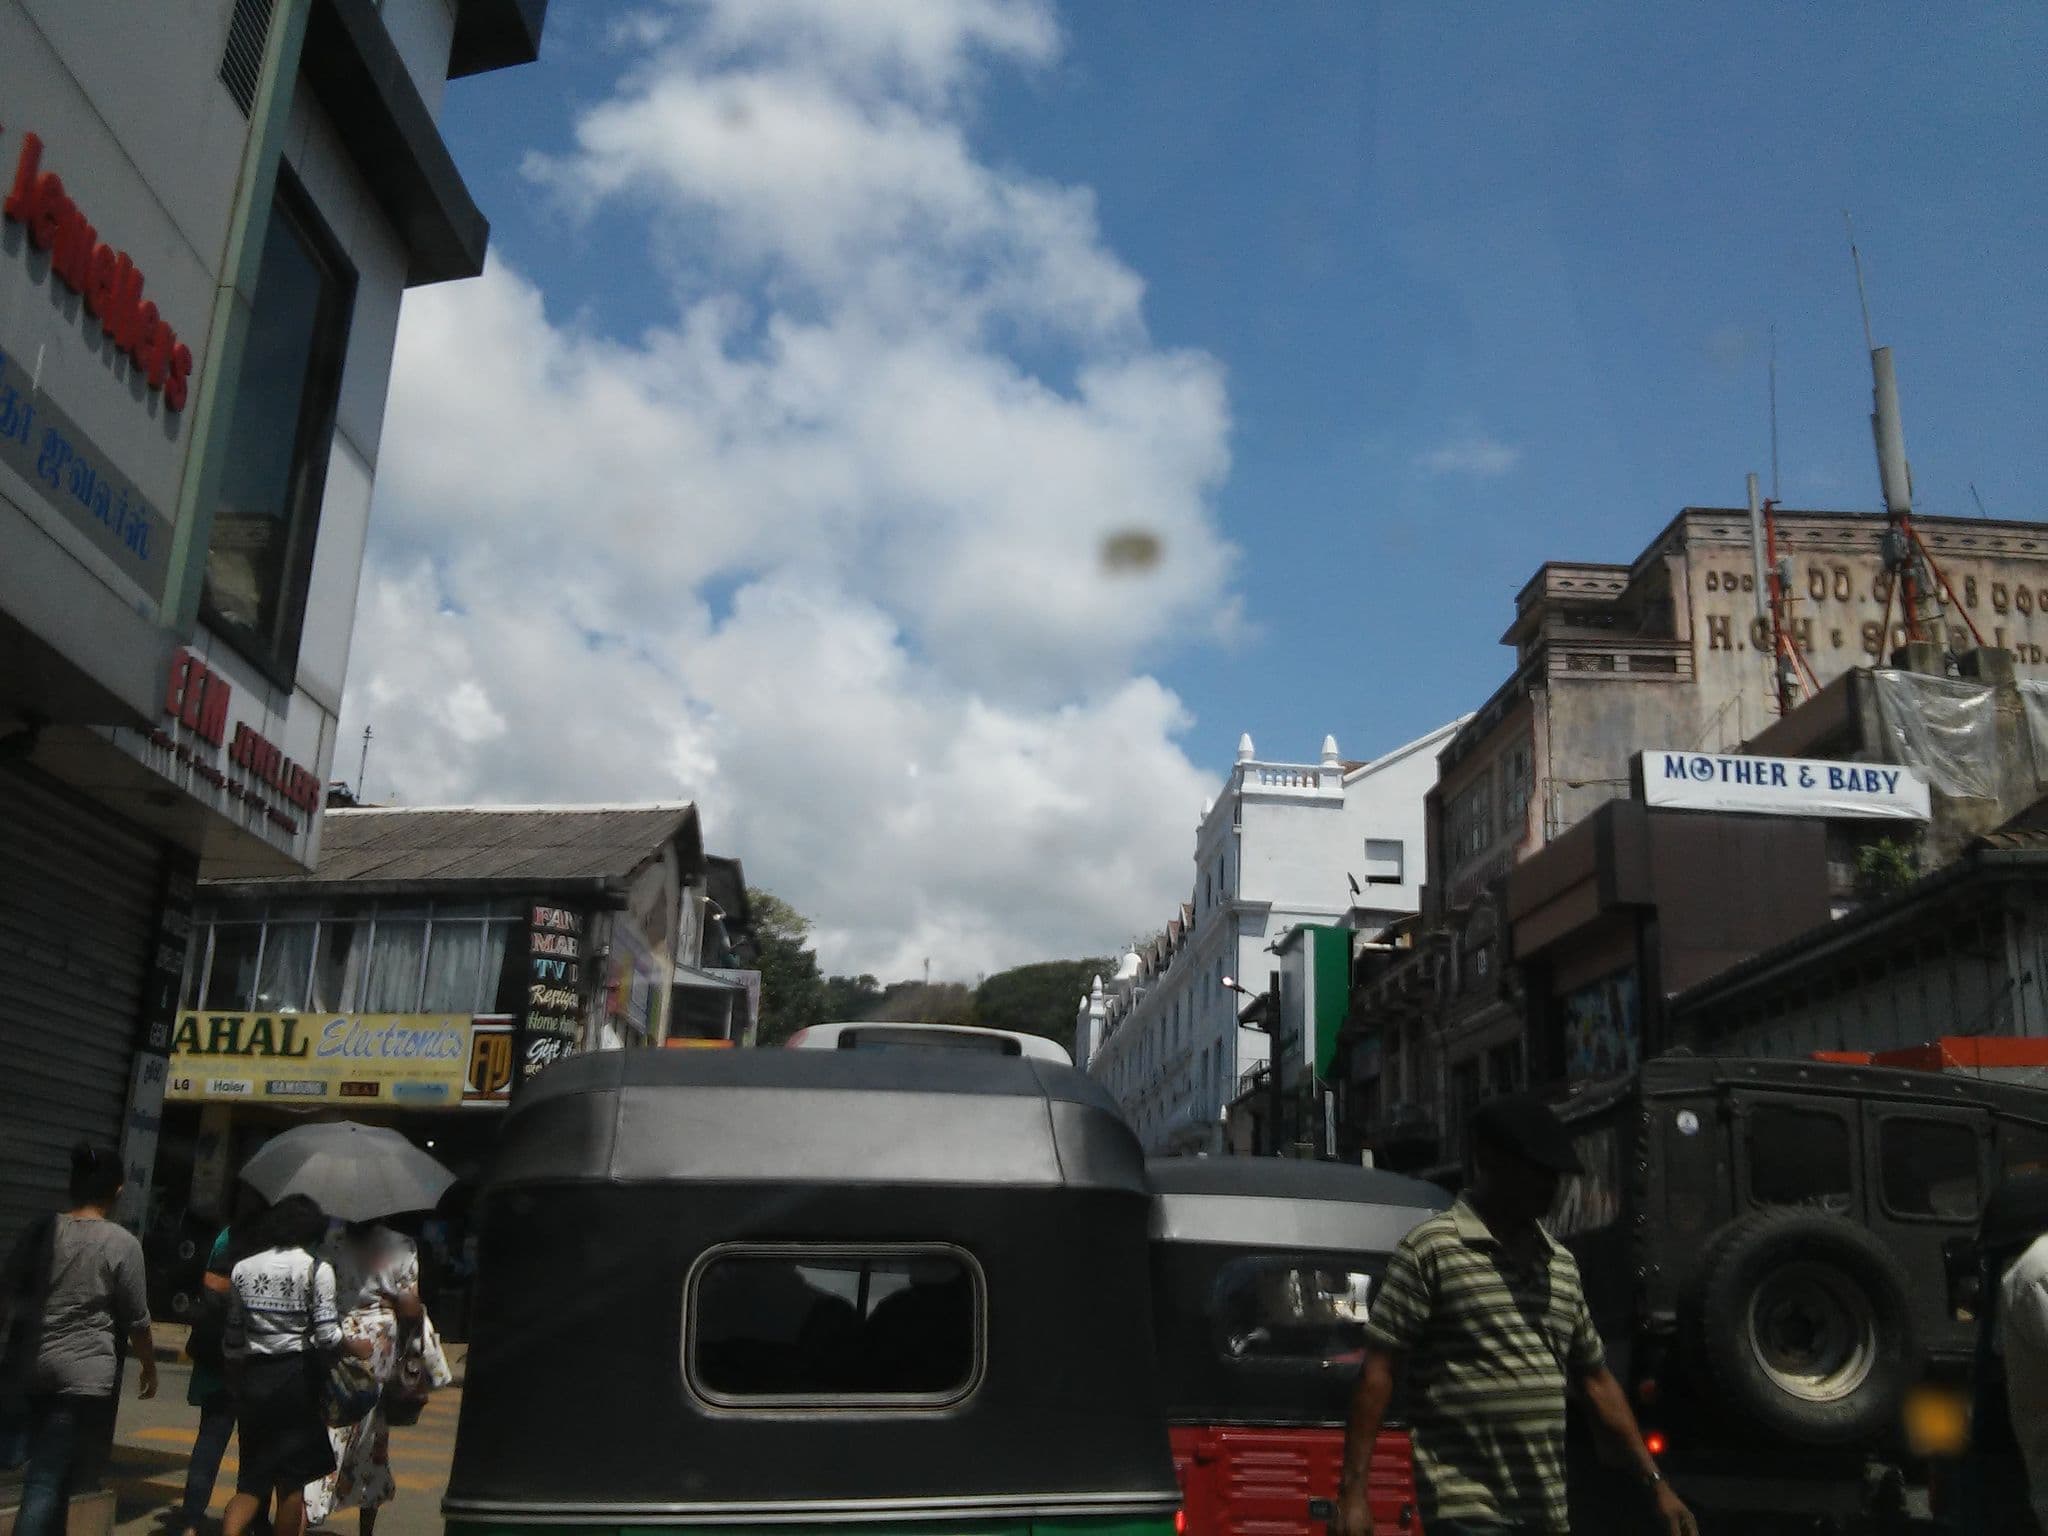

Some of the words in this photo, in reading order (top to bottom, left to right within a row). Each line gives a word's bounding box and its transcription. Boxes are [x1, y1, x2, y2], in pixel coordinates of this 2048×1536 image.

[1664, 755, 1788, 787] MOTHER
[1798, 766, 1816, 788] &
[1828, 766, 1901, 794] BABY
[535, 958, 567, 980] TV
[526, 1037, 561, 1064] Gift
[173, 1078, 190, 1091] LG
